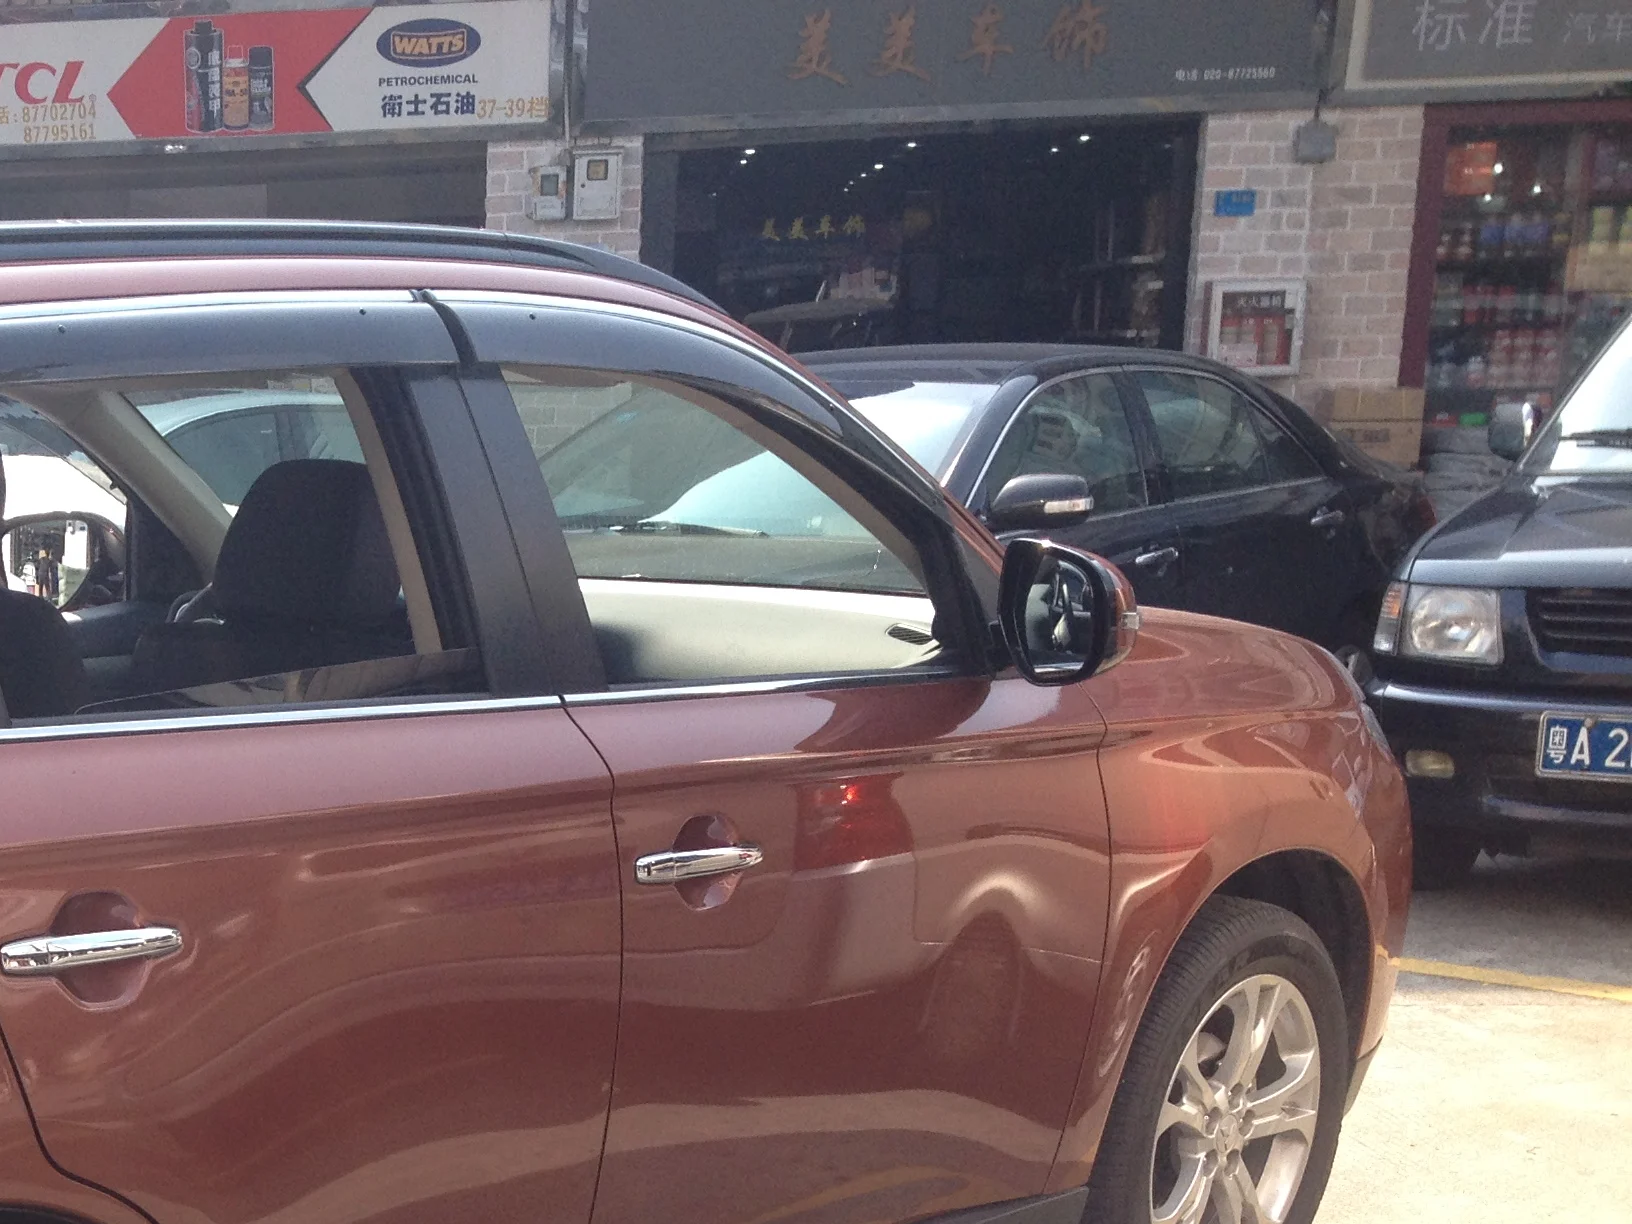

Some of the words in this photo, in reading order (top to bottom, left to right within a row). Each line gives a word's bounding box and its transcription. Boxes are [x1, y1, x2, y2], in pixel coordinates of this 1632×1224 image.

[393, 33, 465, 55] WATTS
[378, 74, 478, 87] PETROCHEMICAL
[381, 91, 476, 118] 衛士石油
[23, 122, 97, 144] 87795161
